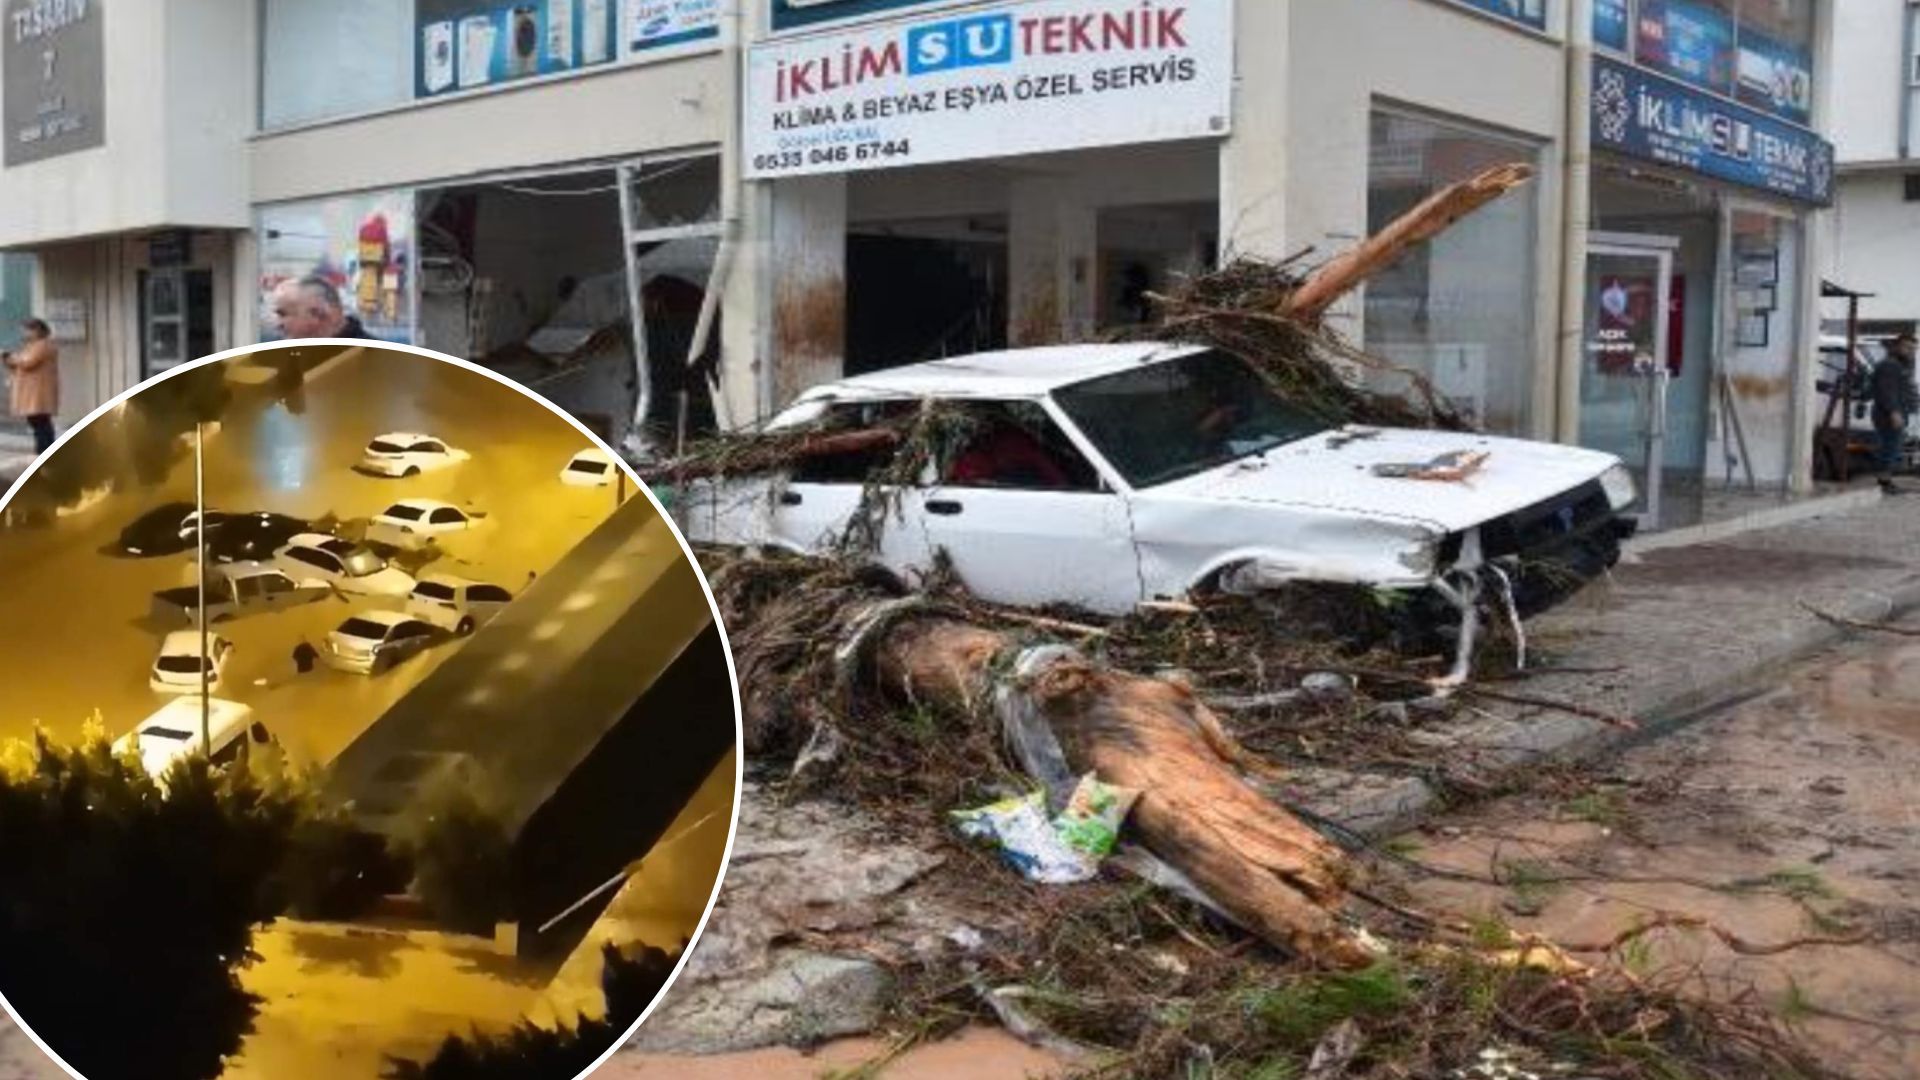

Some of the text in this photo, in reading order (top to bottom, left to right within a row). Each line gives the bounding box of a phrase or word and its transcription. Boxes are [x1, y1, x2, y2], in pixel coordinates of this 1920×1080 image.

[772, 55, 1197, 130] KLİMA & BEYAZ EŞYA ÖZEL SERVİS
[776, 41, 902, 103] İKLİM
[1019, 1, 1188, 56] TEKNİK
